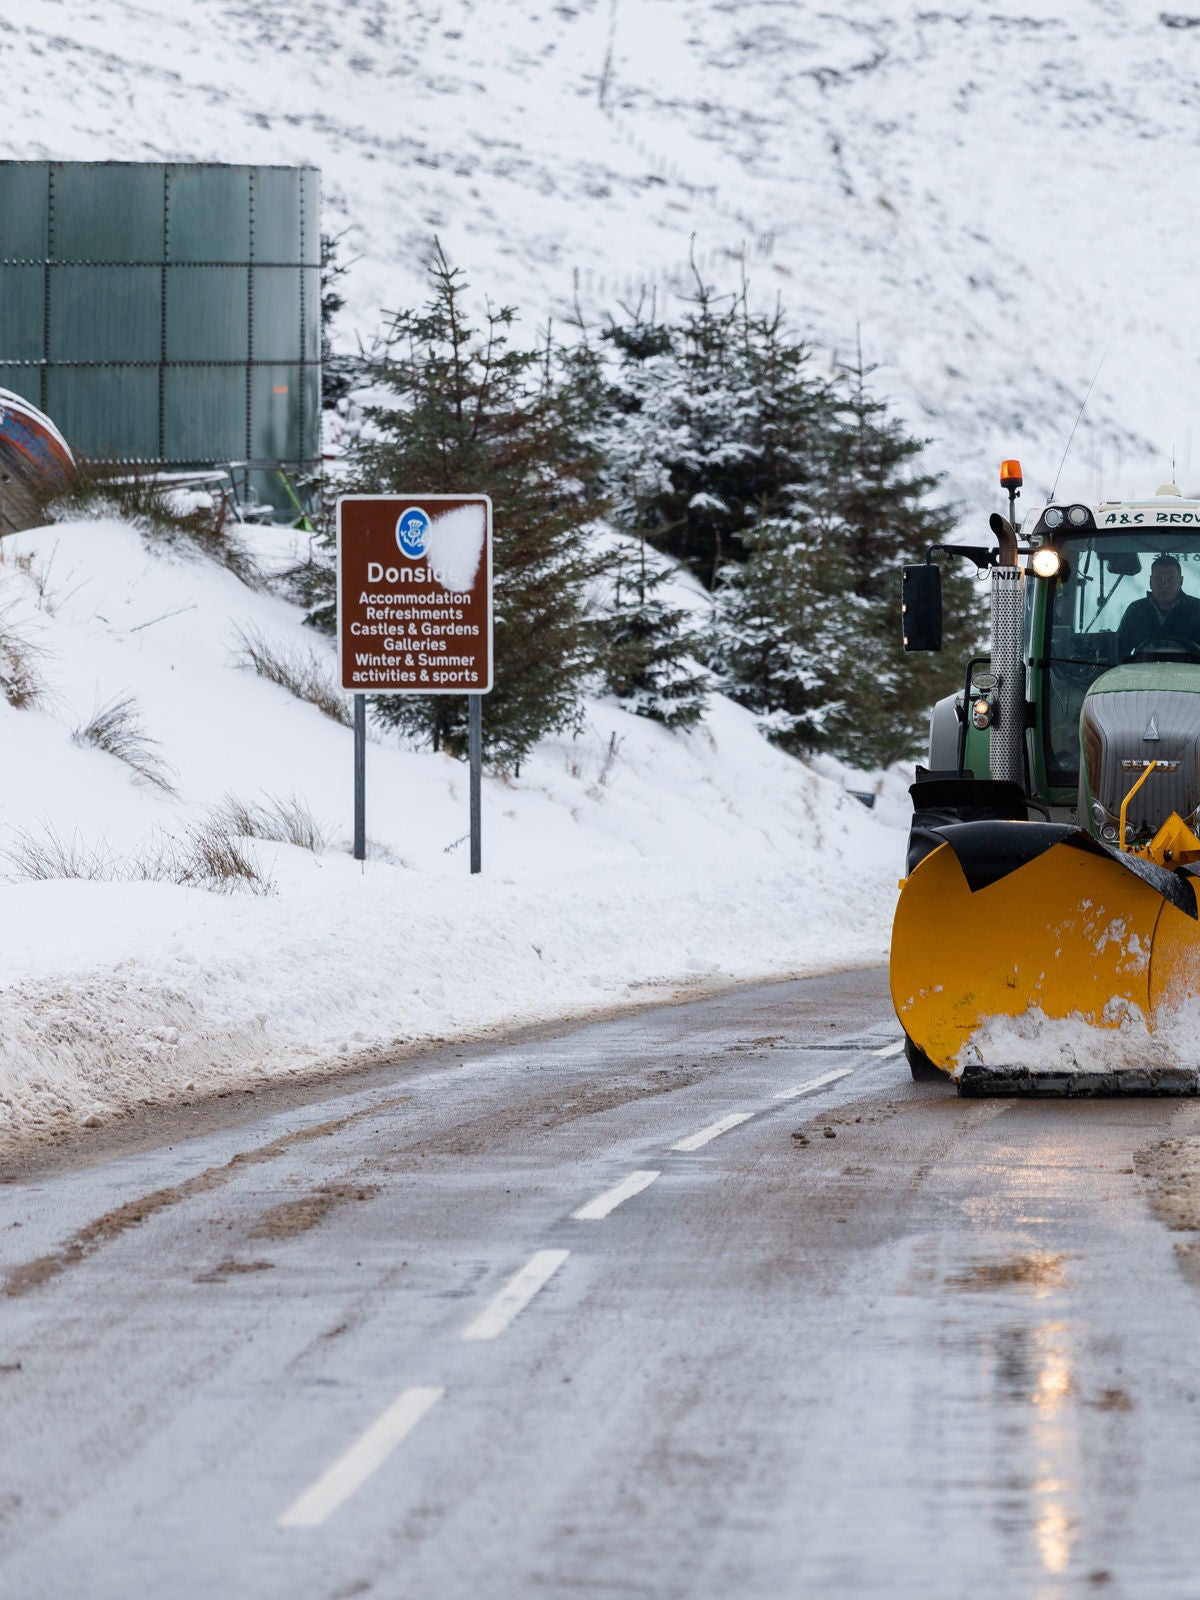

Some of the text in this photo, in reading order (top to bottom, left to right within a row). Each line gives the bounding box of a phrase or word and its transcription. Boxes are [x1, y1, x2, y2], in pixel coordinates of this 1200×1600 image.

[1105, 513, 1144, 524] A&S
[367, 562, 447, 583] Donsi
[359, 591, 471, 605] Accommodation
[366, 607, 463, 620] Refreshments
[350, 622, 479, 635] Castles & Gardens
[383, 638, 447, 651] Galleries
[355, 653, 475, 666] Winter & Summer
[352, 669, 478, 684] activities & sports
